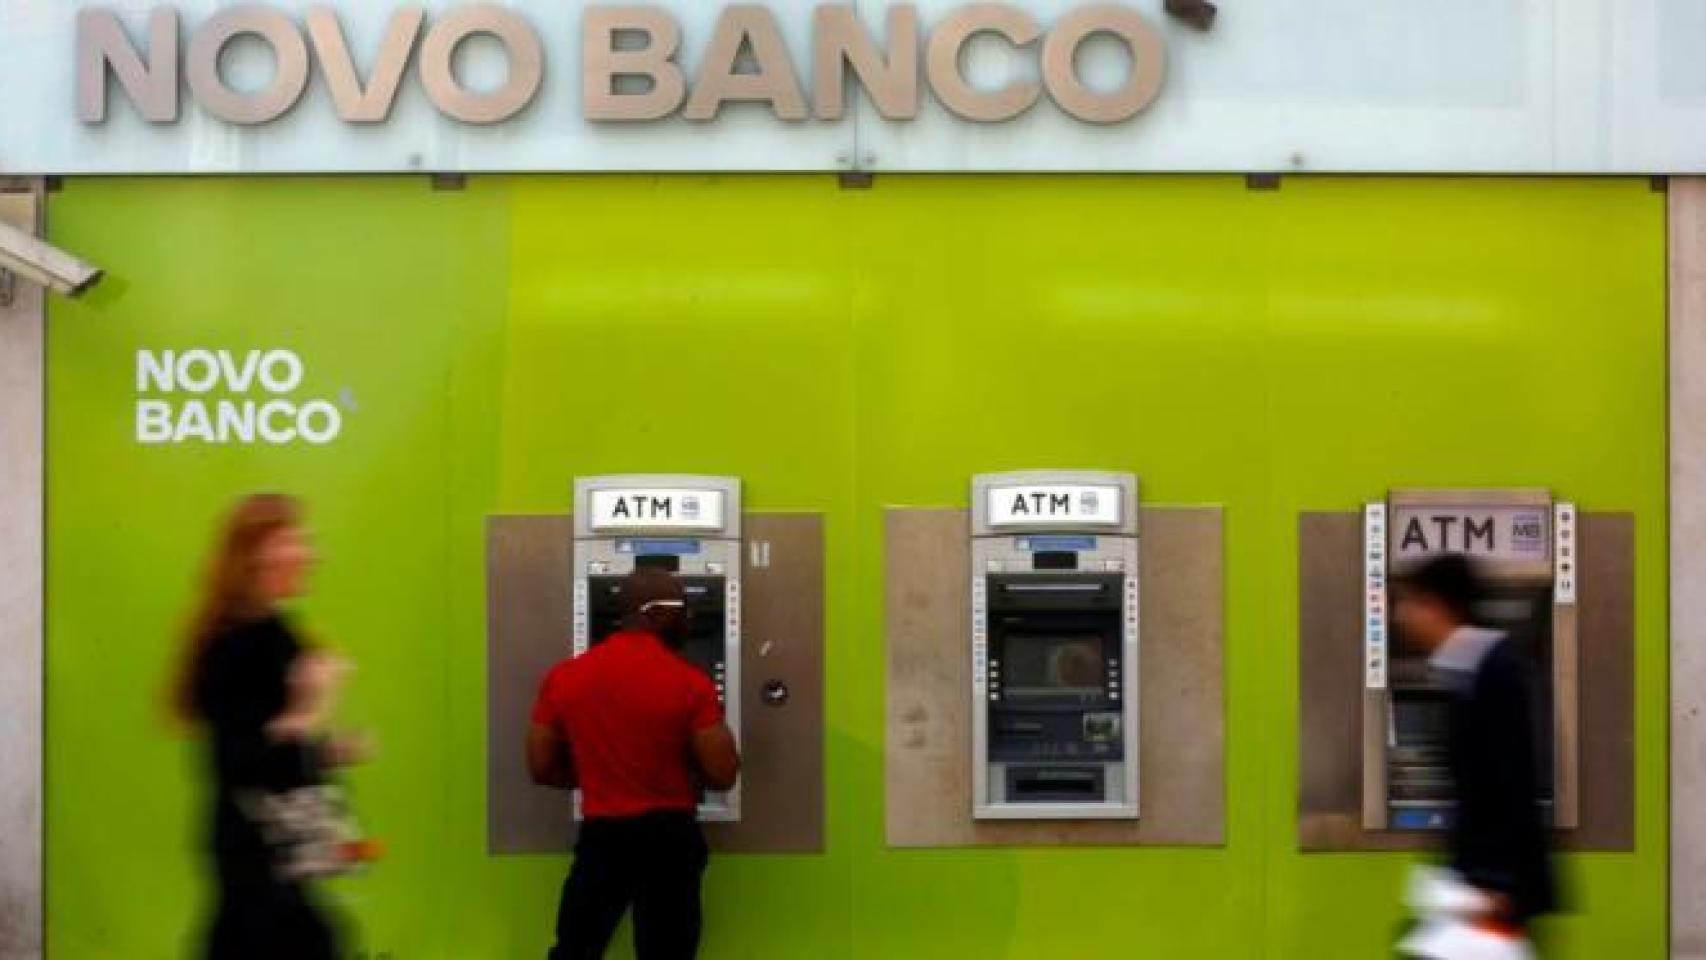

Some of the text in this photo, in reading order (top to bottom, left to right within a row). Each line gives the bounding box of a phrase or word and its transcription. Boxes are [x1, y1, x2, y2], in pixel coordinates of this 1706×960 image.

[76, 4, 1166, 124] NOVO BANCO
[135, 348, 303, 394] NOVO
[135, 398, 342, 445] BANCO
[612, 496, 673, 518] ATM
[1011, 493, 1070, 515] ATM
[1401, 516, 1496, 551] ATM
